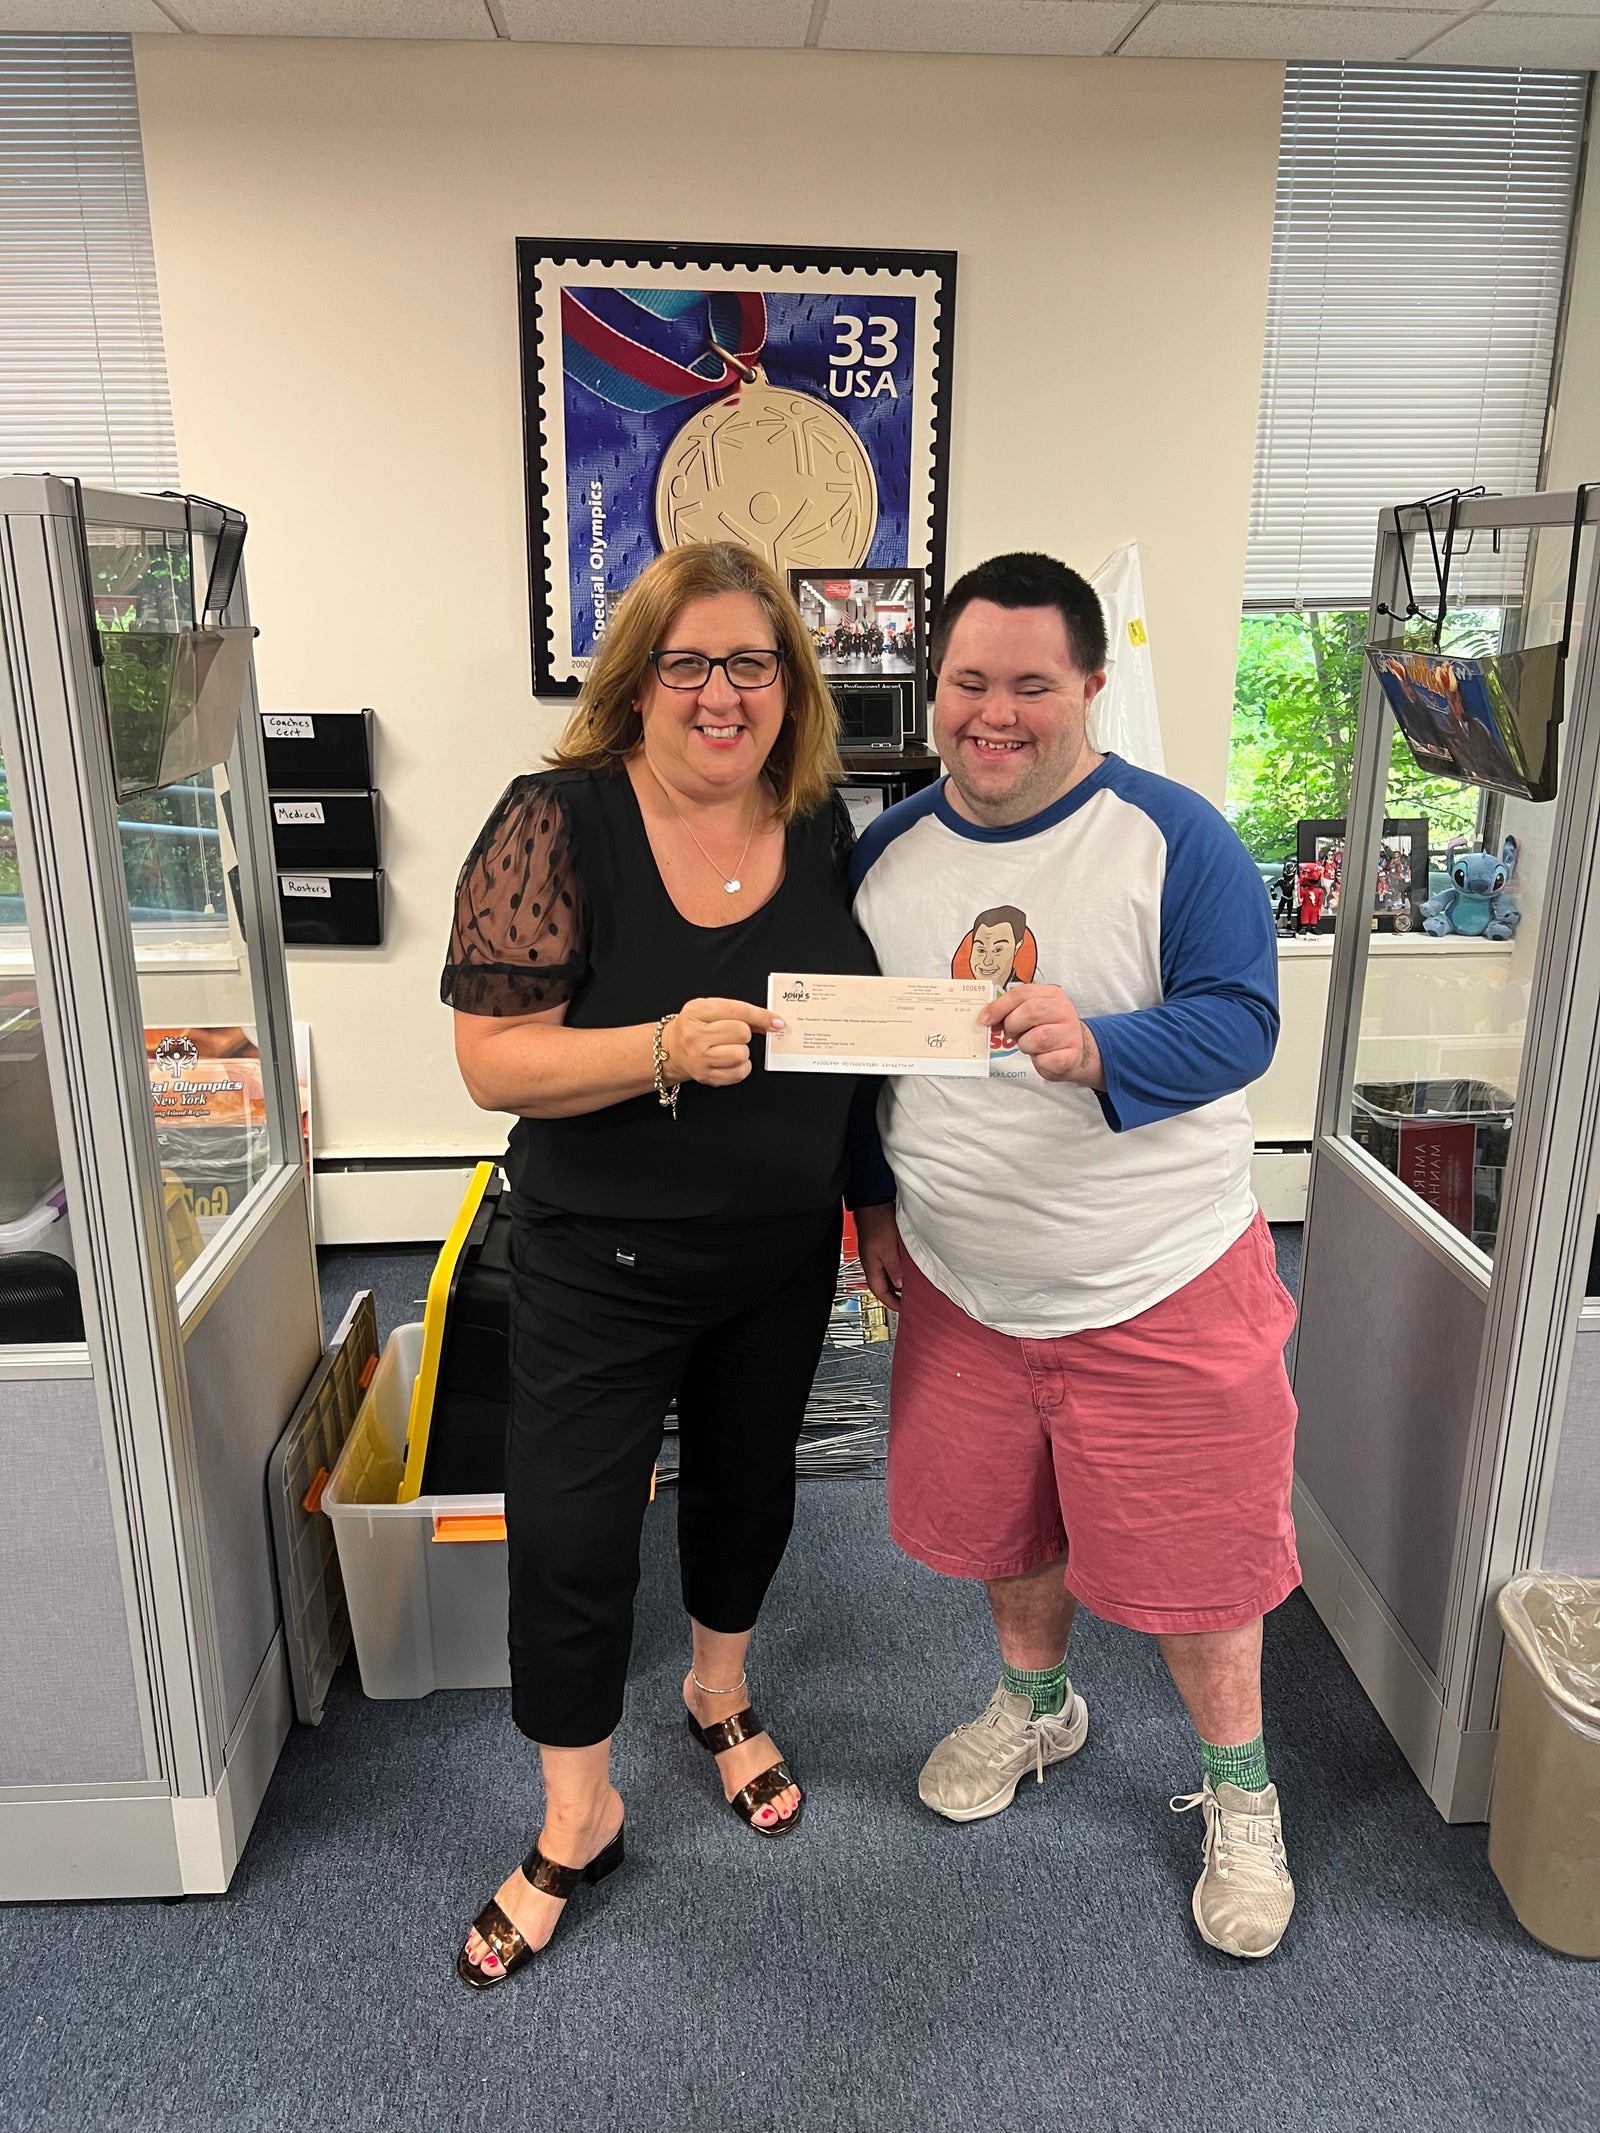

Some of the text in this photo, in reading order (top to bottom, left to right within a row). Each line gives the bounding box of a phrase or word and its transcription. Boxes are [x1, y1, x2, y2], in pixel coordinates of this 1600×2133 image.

[829, 315, 899, 367] 33
[829, 369, 899, 399] USA
[590, 481, 608, 641] Special Olympics
[269, 717, 310, 729] Coaches
[276, 728, 302, 737] Cert
[278, 807, 322, 820] Medical
[288, 881, 327, 894] Rosters
[173, 1080, 244, 1094] Olympics
[152, 1093, 207, 1106] New York
